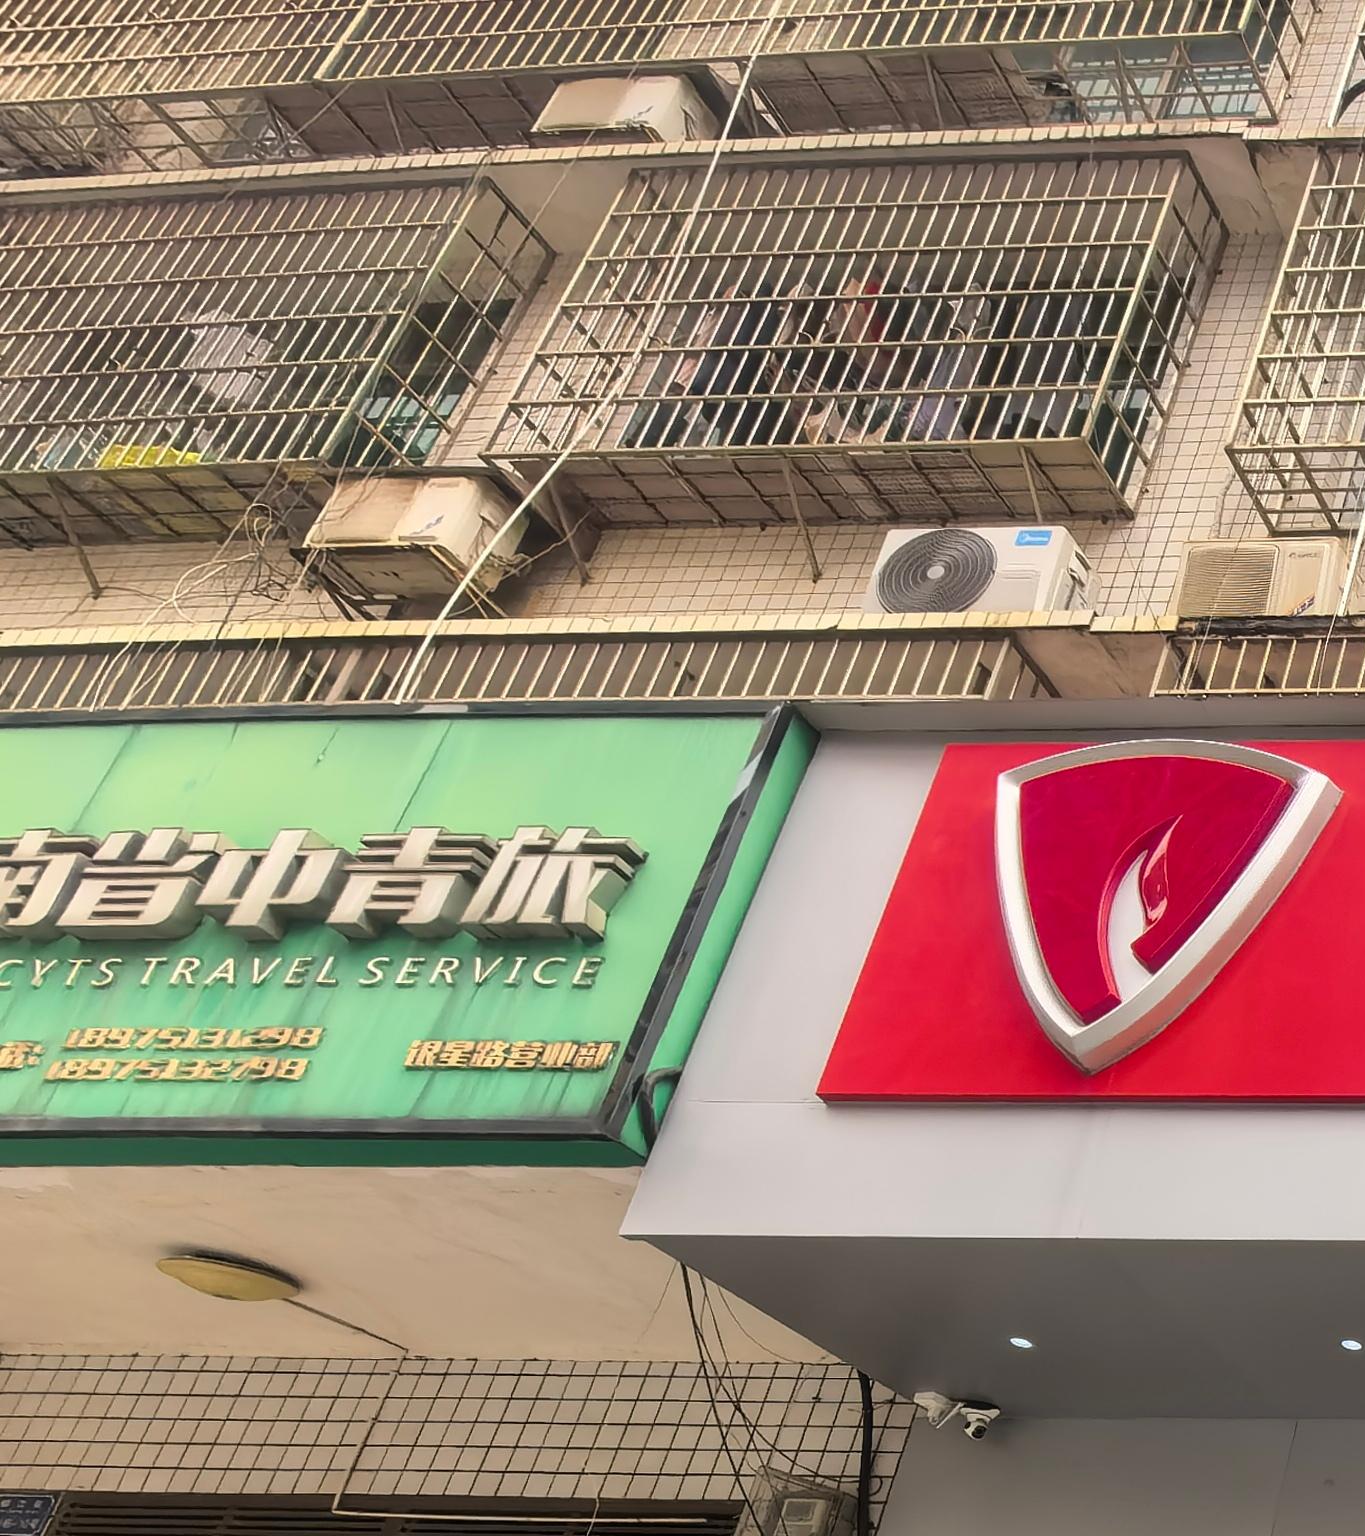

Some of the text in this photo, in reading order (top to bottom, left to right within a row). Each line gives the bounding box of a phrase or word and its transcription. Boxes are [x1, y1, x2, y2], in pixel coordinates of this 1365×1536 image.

[0, 956, 604, 989] CYTS TRAVEL SERVICE
[404, 1039, 618, 1071] 银星路营业部
